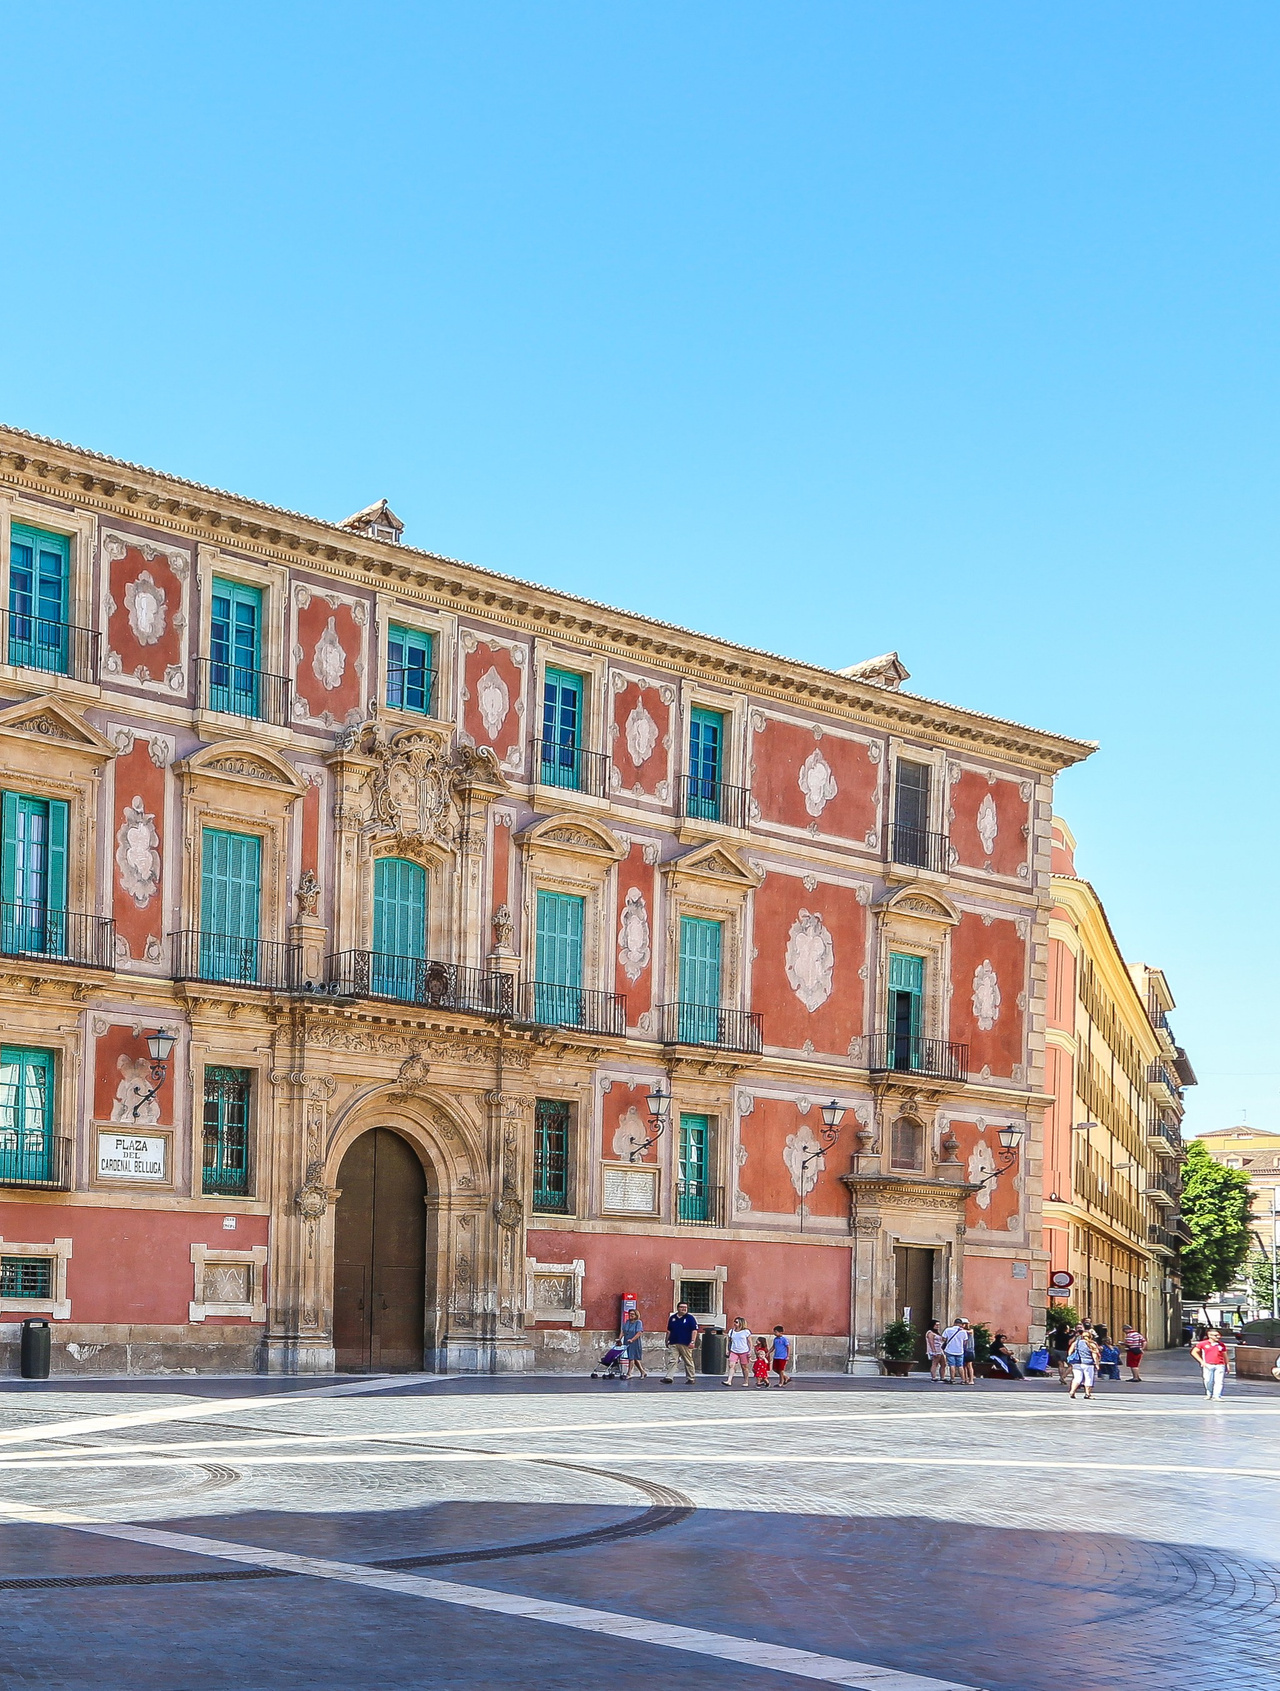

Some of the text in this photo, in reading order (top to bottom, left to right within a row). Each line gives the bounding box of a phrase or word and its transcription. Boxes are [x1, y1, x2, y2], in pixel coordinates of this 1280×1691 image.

[115, 1139, 148, 1151] PLAZA
[123, 1151, 140, 1159] DEL
[101, 1158, 162, 1174] CARDENAL BELLUGA
